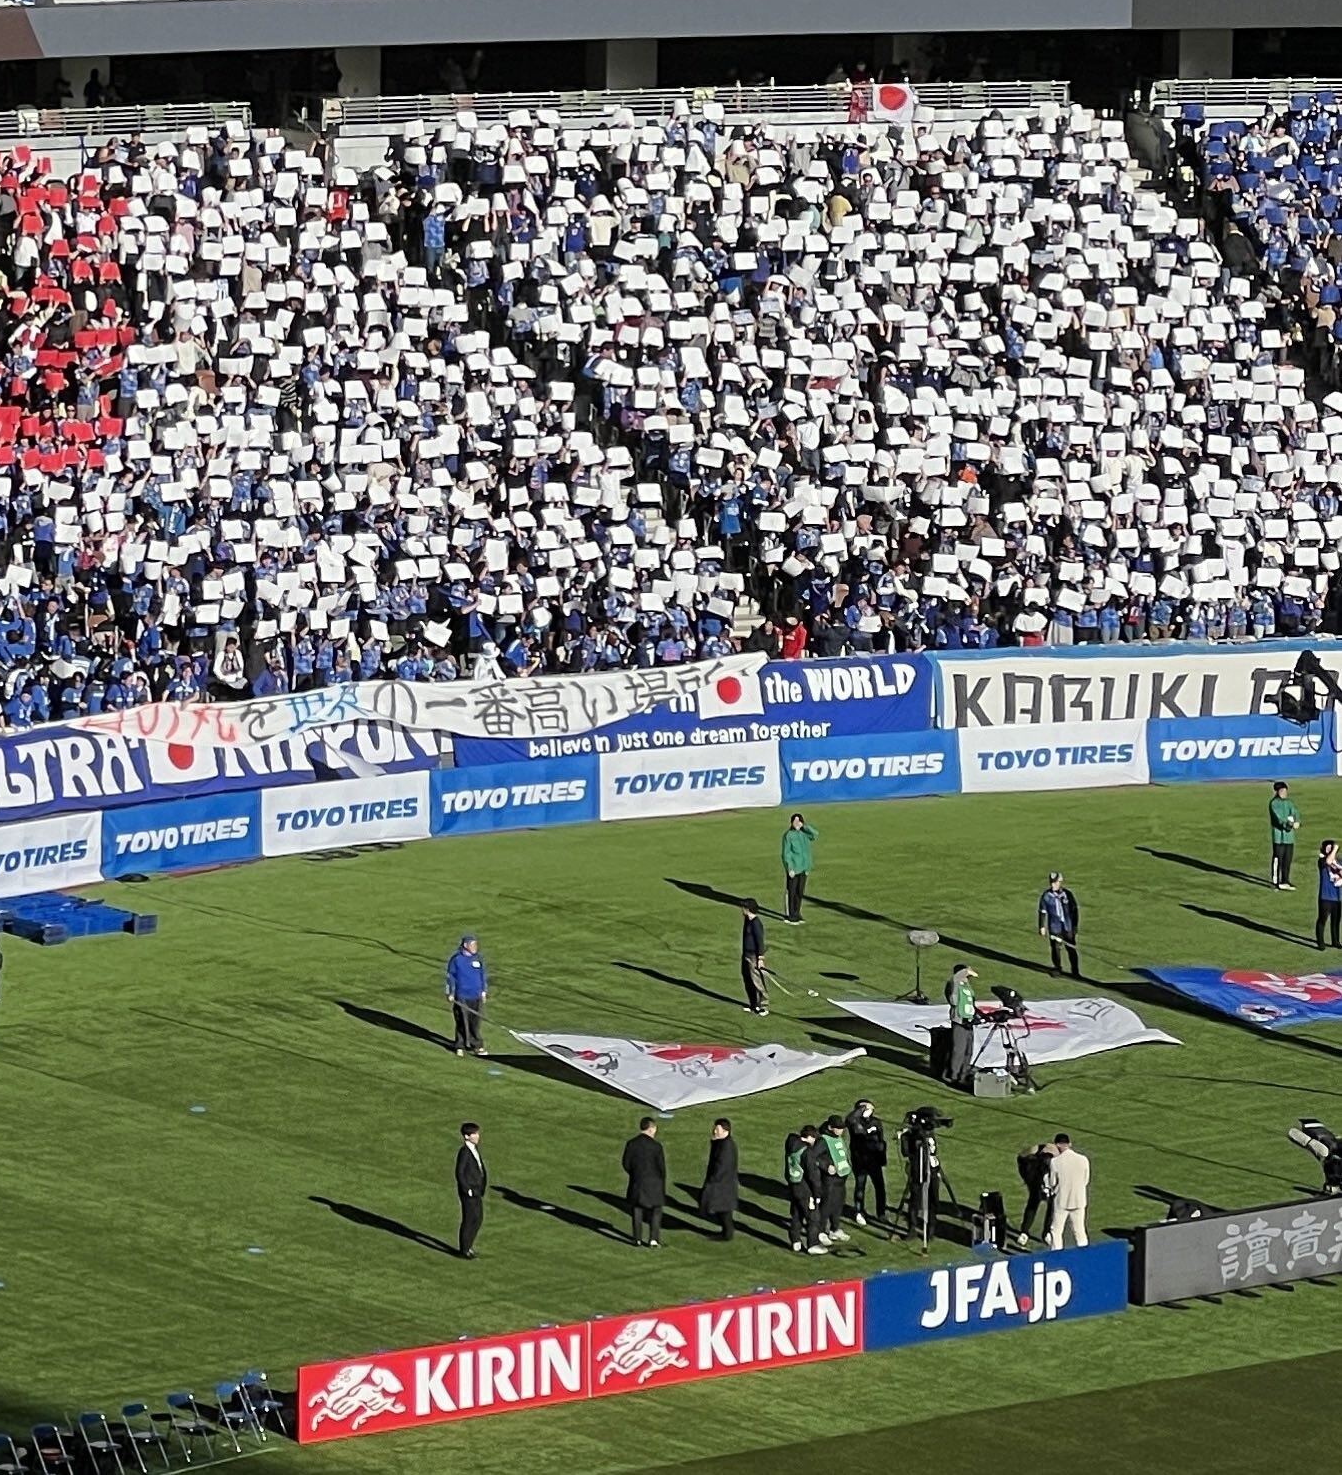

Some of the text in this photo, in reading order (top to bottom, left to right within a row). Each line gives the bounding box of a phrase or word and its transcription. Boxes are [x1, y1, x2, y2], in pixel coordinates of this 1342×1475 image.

[765, 672, 803, 704] the
[803, 663, 917, 702] WORLD
[529, 720, 831, 758] believe in just one dream together
[977, 743, 1135, 772] TOYO TIRES
[1159, 733, 1323, 762] TOYO TIRES
[614, 765, 766, 795] TOYO TIRES
[790, 752, 945, 783] TOYO TIRES
[275, 796, 419, 833] TOYO TIRES
[441, 779, 587, 815] TOYO TIRES
[23, 839, 90, 868] TIRES
[114, 816, 251, 856] TOYO TIRES
[920, 1260, 1073, 1329] JFA.jp
[698, 1290, 856, 1370] KIRIN
[415, 1334, 582, 1416] KIRIN
